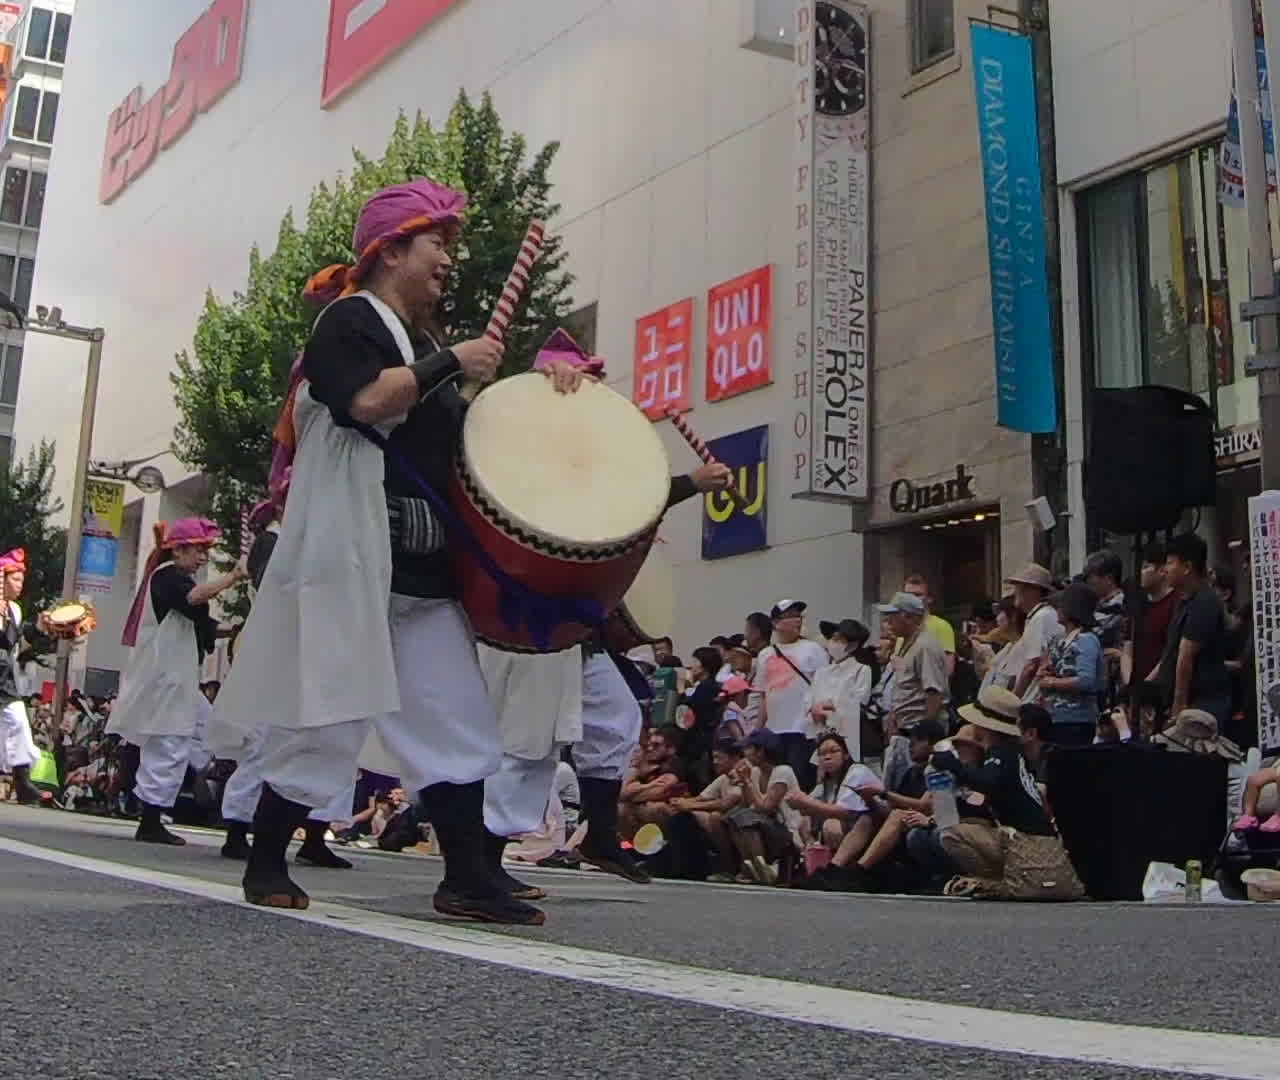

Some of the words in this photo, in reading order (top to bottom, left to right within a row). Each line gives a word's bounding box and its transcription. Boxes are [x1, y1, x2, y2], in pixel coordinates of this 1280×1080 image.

[823, 159, 839, 229] PATEK
[980, 57, 1011, 224] DIAMOND
[795, 164, 810, 307] FREE
[713, 283, 761, 336] UNI
[823, 238, 840, 345] PHILIPPE
[847, 268, 866, 403] PANERAI
[711, 331, 764, 391] QLO
[793, 330, 809, 480] SHOP
[823, 347, 848, 492] ROLEX
[846, 405, 860, 487] OMEGA
[889, 463, 977, 513] Quark
